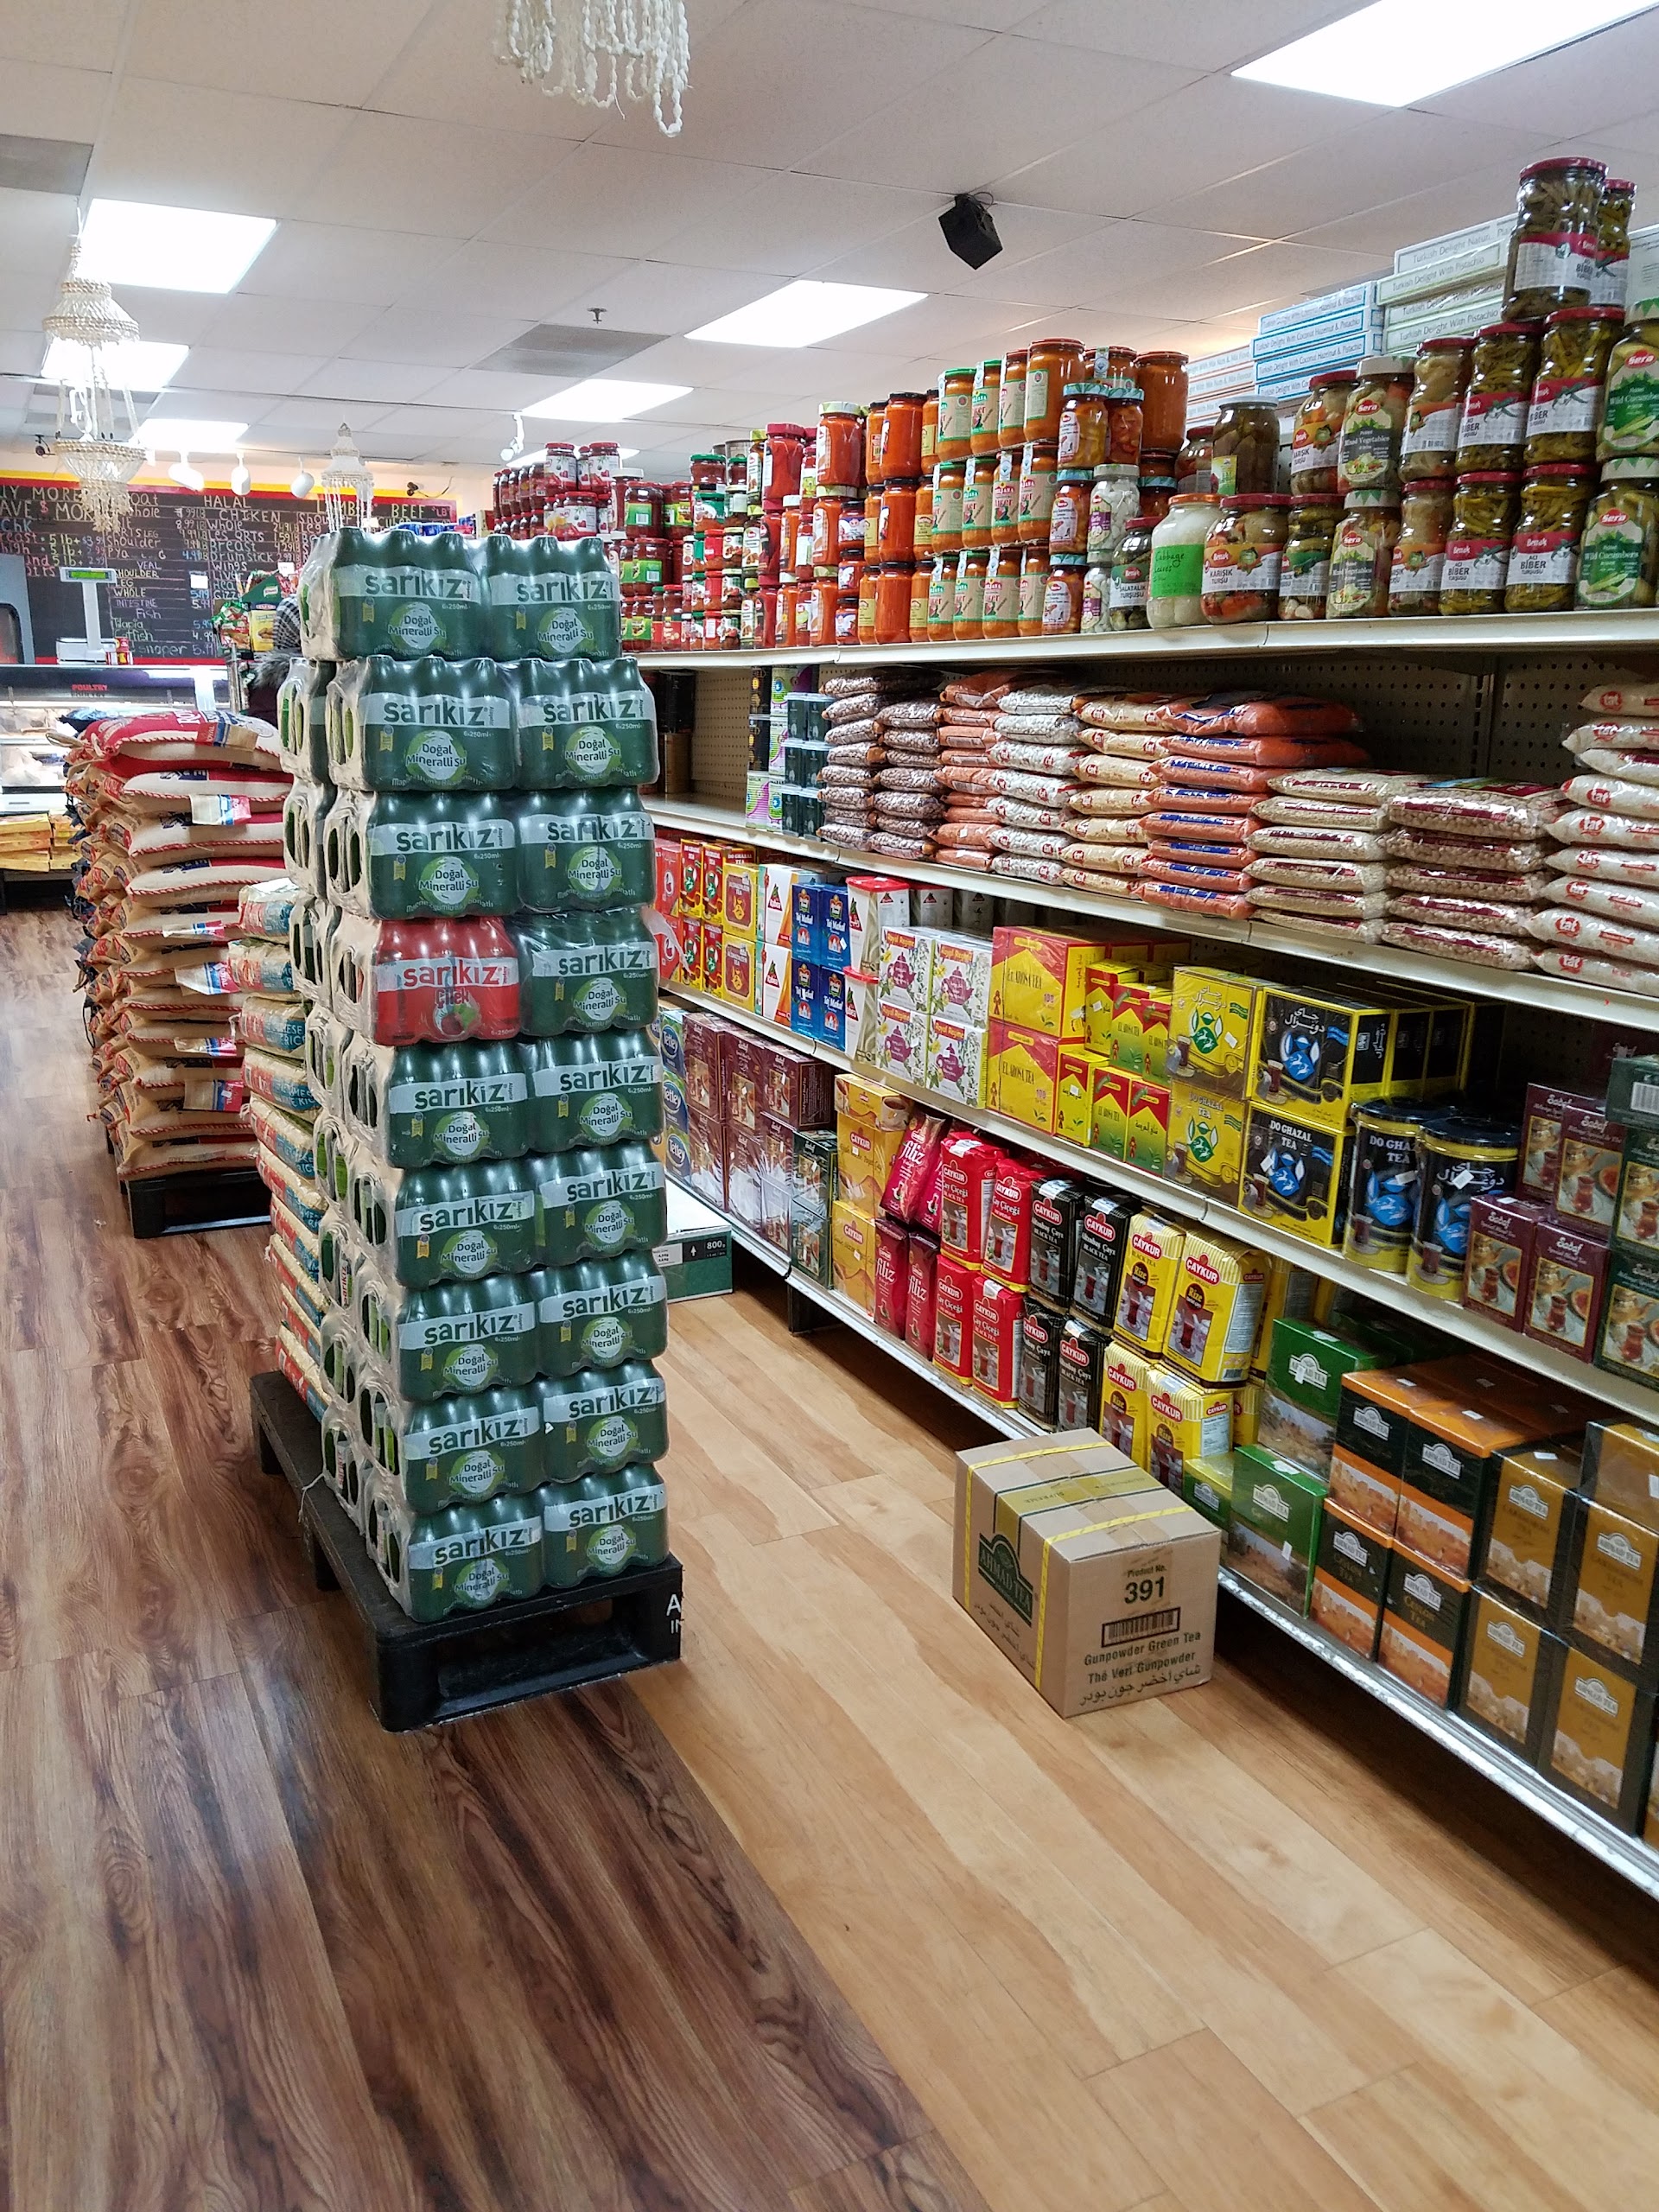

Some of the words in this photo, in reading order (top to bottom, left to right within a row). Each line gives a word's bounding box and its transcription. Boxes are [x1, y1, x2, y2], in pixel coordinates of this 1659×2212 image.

[204, 495, 251, 508] HALAL
[391, 504, 425, 518] BEEF
[389, 626, 432, 637] Mineralli
[537, 629, 578, 641] Mineralli
[406, 753, 453, 766] Mineralli
[566, 749, 607, 761] Mineralli
[569, 868, 609, 880] Mineralli
[420, 880, 464, 891] Mineralli
[574, 997, 613, 1011] Mineralli
[581, 1111, 619, 1125] Mineralli
[586, 1221, 623, 1234] Mineralli
[588, 1435, 626, 1447] Mineralli
[1124, 1577, 1164, 1604] 391
[1084, 1644, 1144, 1666] Gunpowder
[1148, 1637, 1179, 1651] Green
[1184, 1631, 1201, 1643] Tea
[1137, 1652, 1195, 1672] Gunpowder
